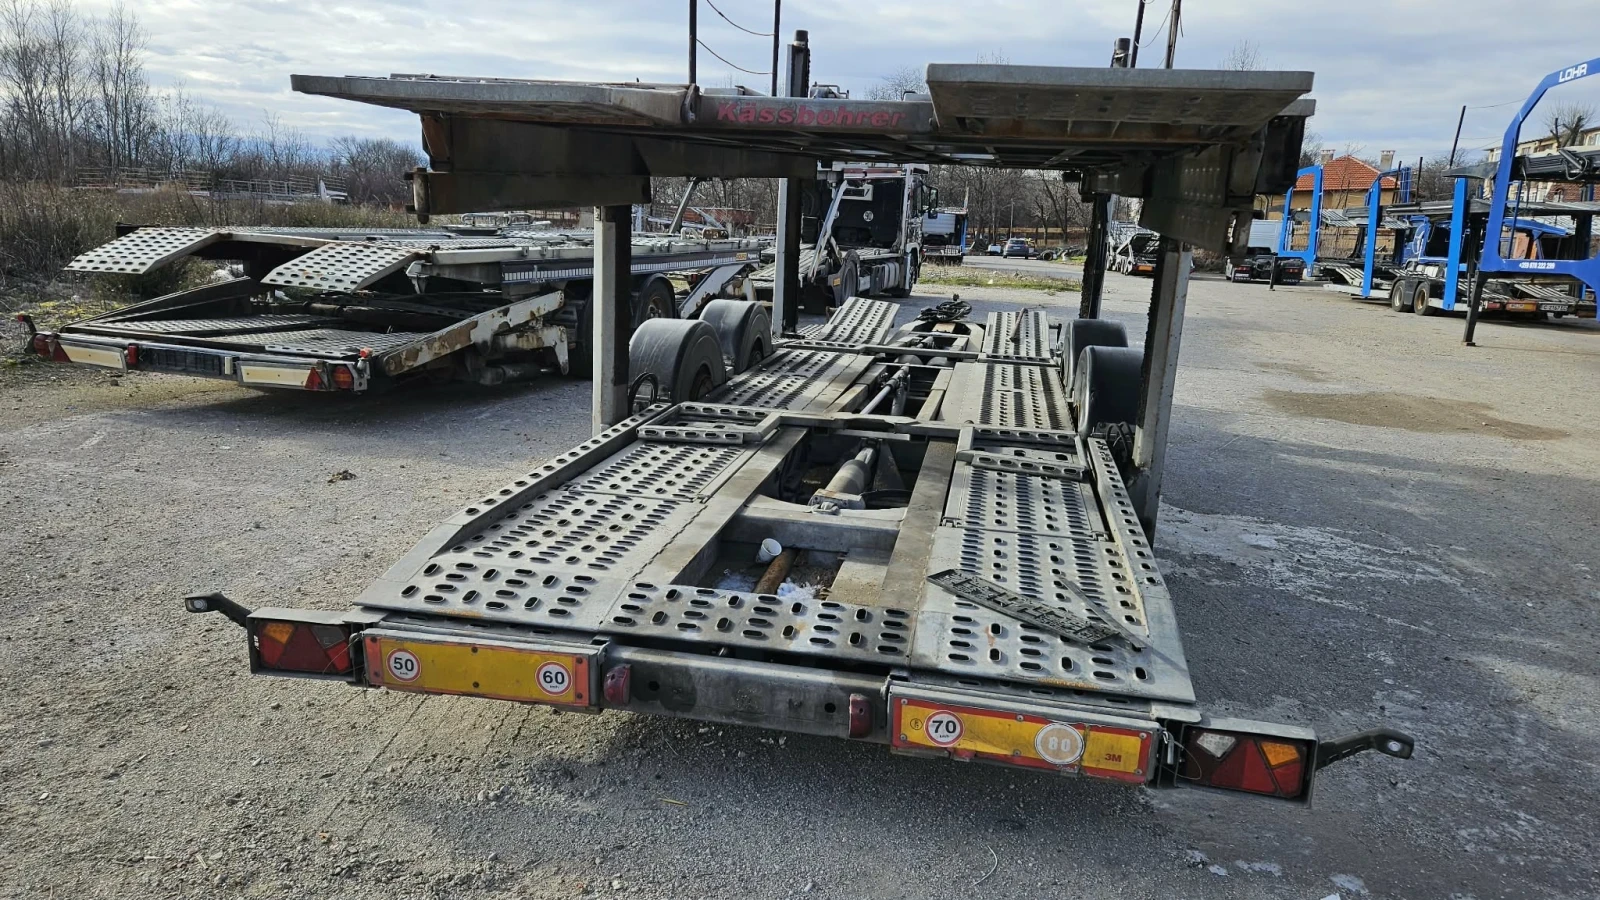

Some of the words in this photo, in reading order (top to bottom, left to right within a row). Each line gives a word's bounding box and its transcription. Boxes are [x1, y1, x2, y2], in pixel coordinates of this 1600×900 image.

[716, 102, 907, 127] Kässbohrer
[393, 657, 414, 672] 50
[542, 670, 565, 685] 60
[932, 720, 957, 734] 70
[1104, 752, 1122, 763] 3M
